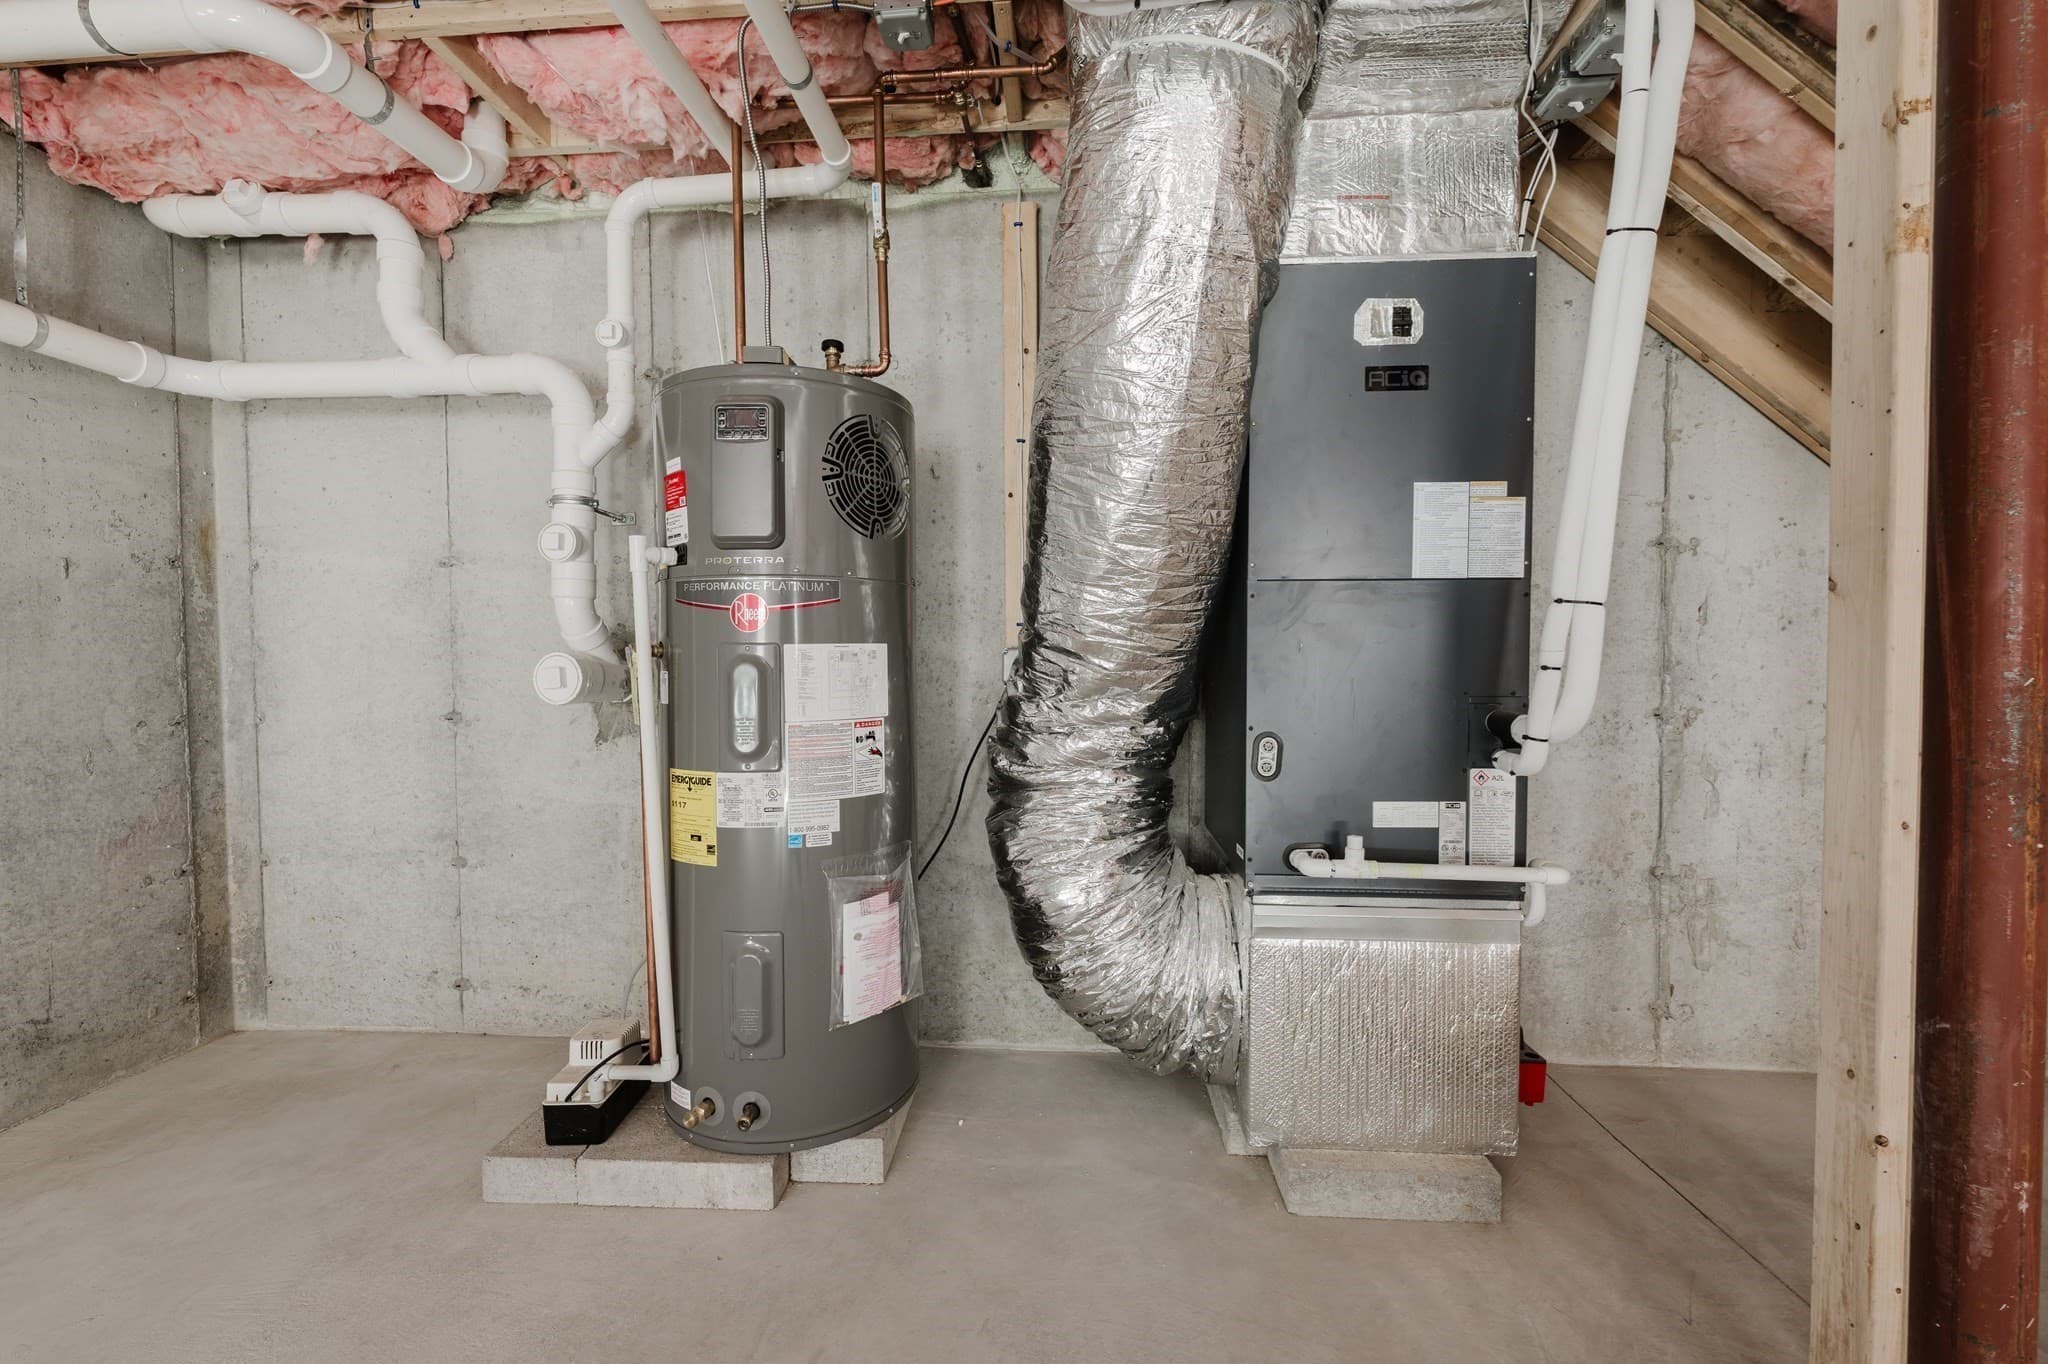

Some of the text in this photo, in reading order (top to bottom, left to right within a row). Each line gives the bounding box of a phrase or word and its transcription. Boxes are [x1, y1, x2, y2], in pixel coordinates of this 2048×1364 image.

[704, 556, 785, 565] PROTERRA
[684, 580, 824, 592] PERFORMANCE PLATINUM
